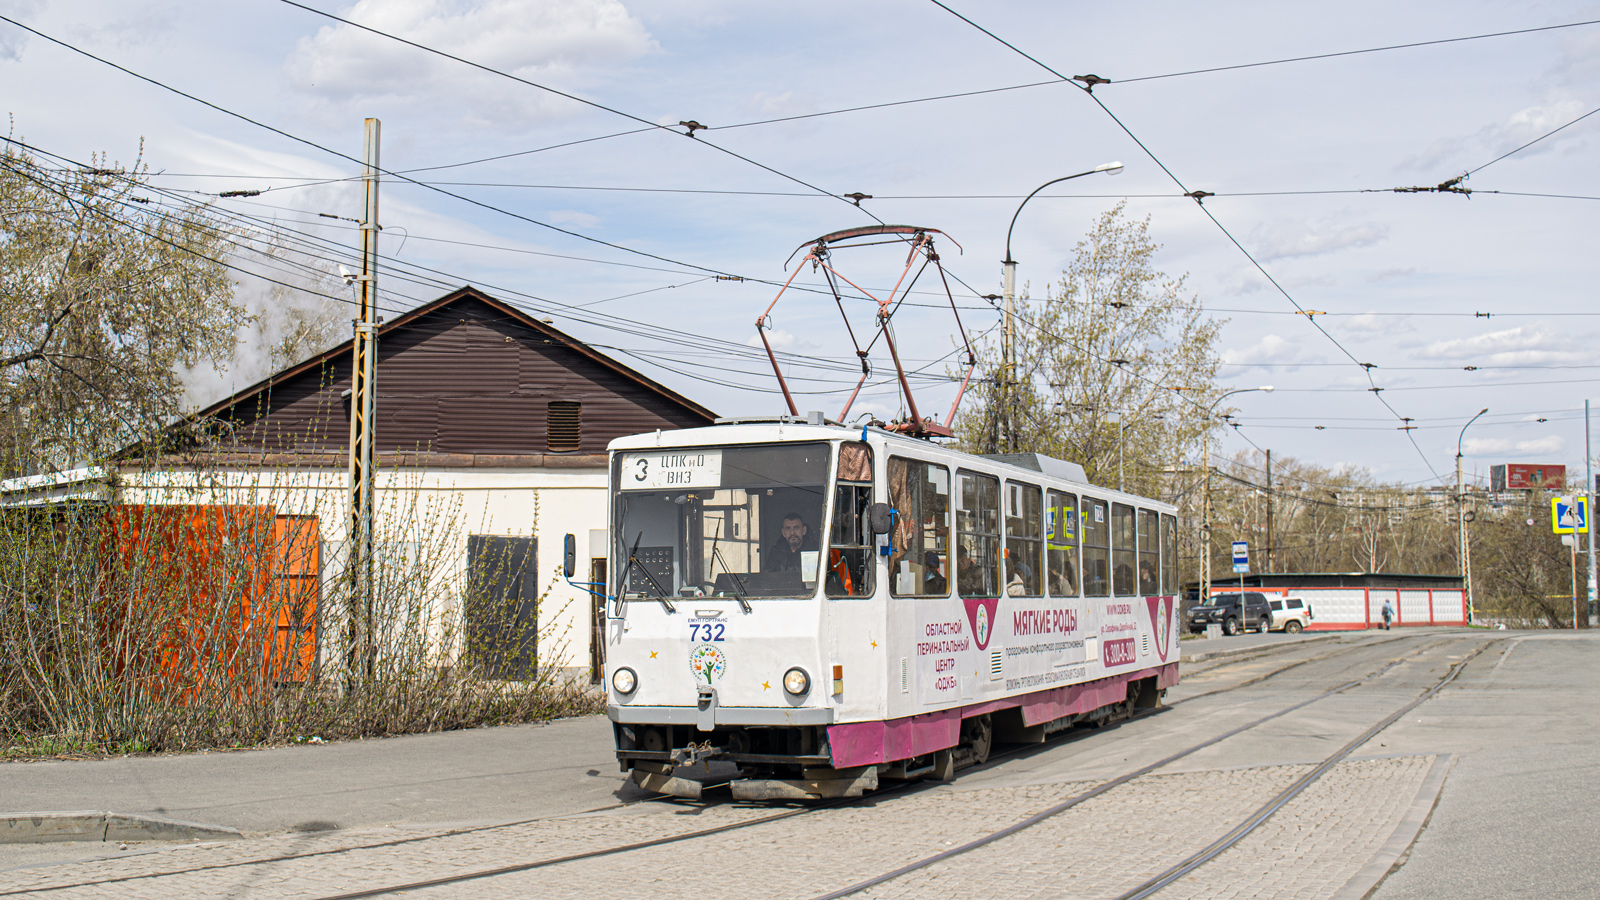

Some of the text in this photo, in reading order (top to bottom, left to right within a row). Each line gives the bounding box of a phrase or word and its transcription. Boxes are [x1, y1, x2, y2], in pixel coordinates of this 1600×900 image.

[635, 458, 649, 482] 3
[925, 619, 963, 637] ОБЛАСТНОЙ
[1013, 609, 1077, 636] МЯГКИЕ РОДЫ
[689, 623, 725, 642] 732
[917, 636, 970, 656] ПЕРИНАТАЛЬНЫЙ
[1110, 641, 1135, 663] 300-8-300
[935, 658, 955, 674] ЦЕНТР
[935, 676, 957, 692] «ОДКБ»
